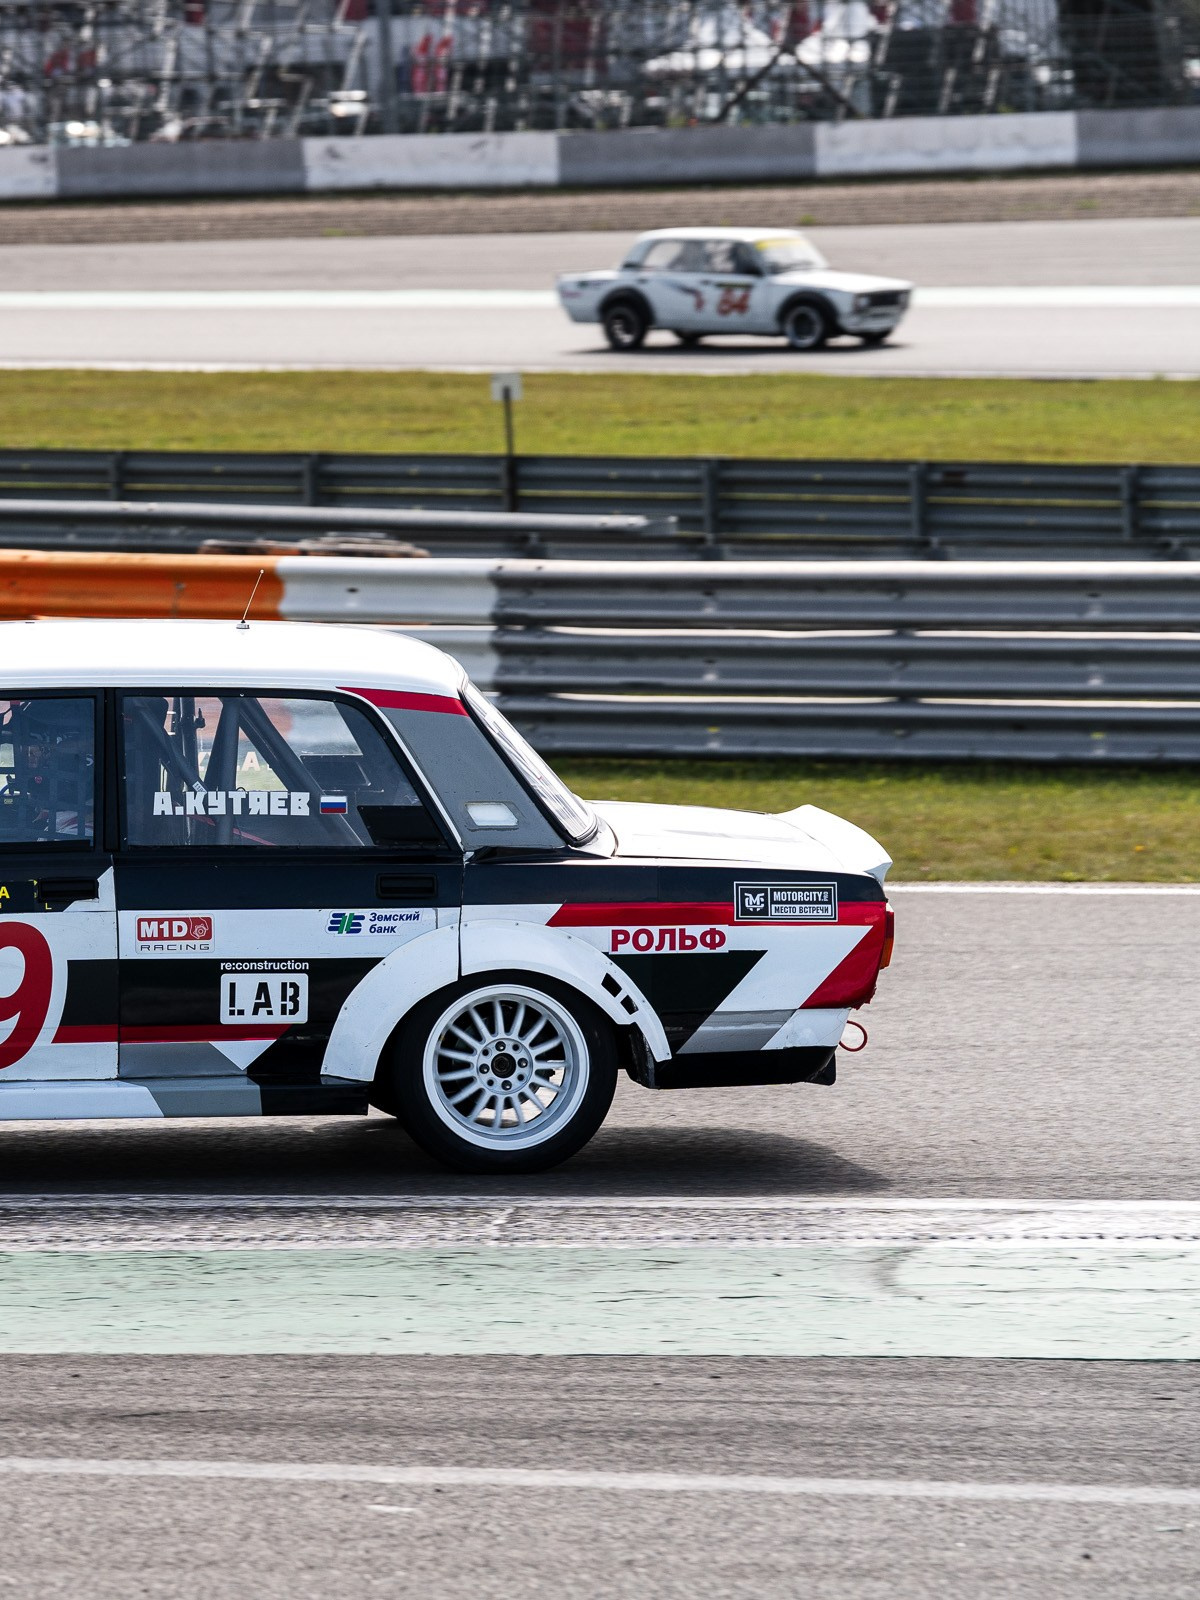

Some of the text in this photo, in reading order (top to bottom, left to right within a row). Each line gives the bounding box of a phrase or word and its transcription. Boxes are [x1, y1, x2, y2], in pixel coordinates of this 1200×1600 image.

[153, 791, 310, 817] А.КУТЯЕВ
[774, 906, 829, 914] МЕСТО ВСТРЕЧИ
[369, 911, 420, 922] Земский
[140, 920, 188, 938] M1D
[369, 924, 398, 934] банк
[611, 927, 727, 952] РОЛЬФ
[140, 943, 210, 952] RACING
[220, 960, 309, 970] re:construction
[228, 981, 300, 1016] LAB
